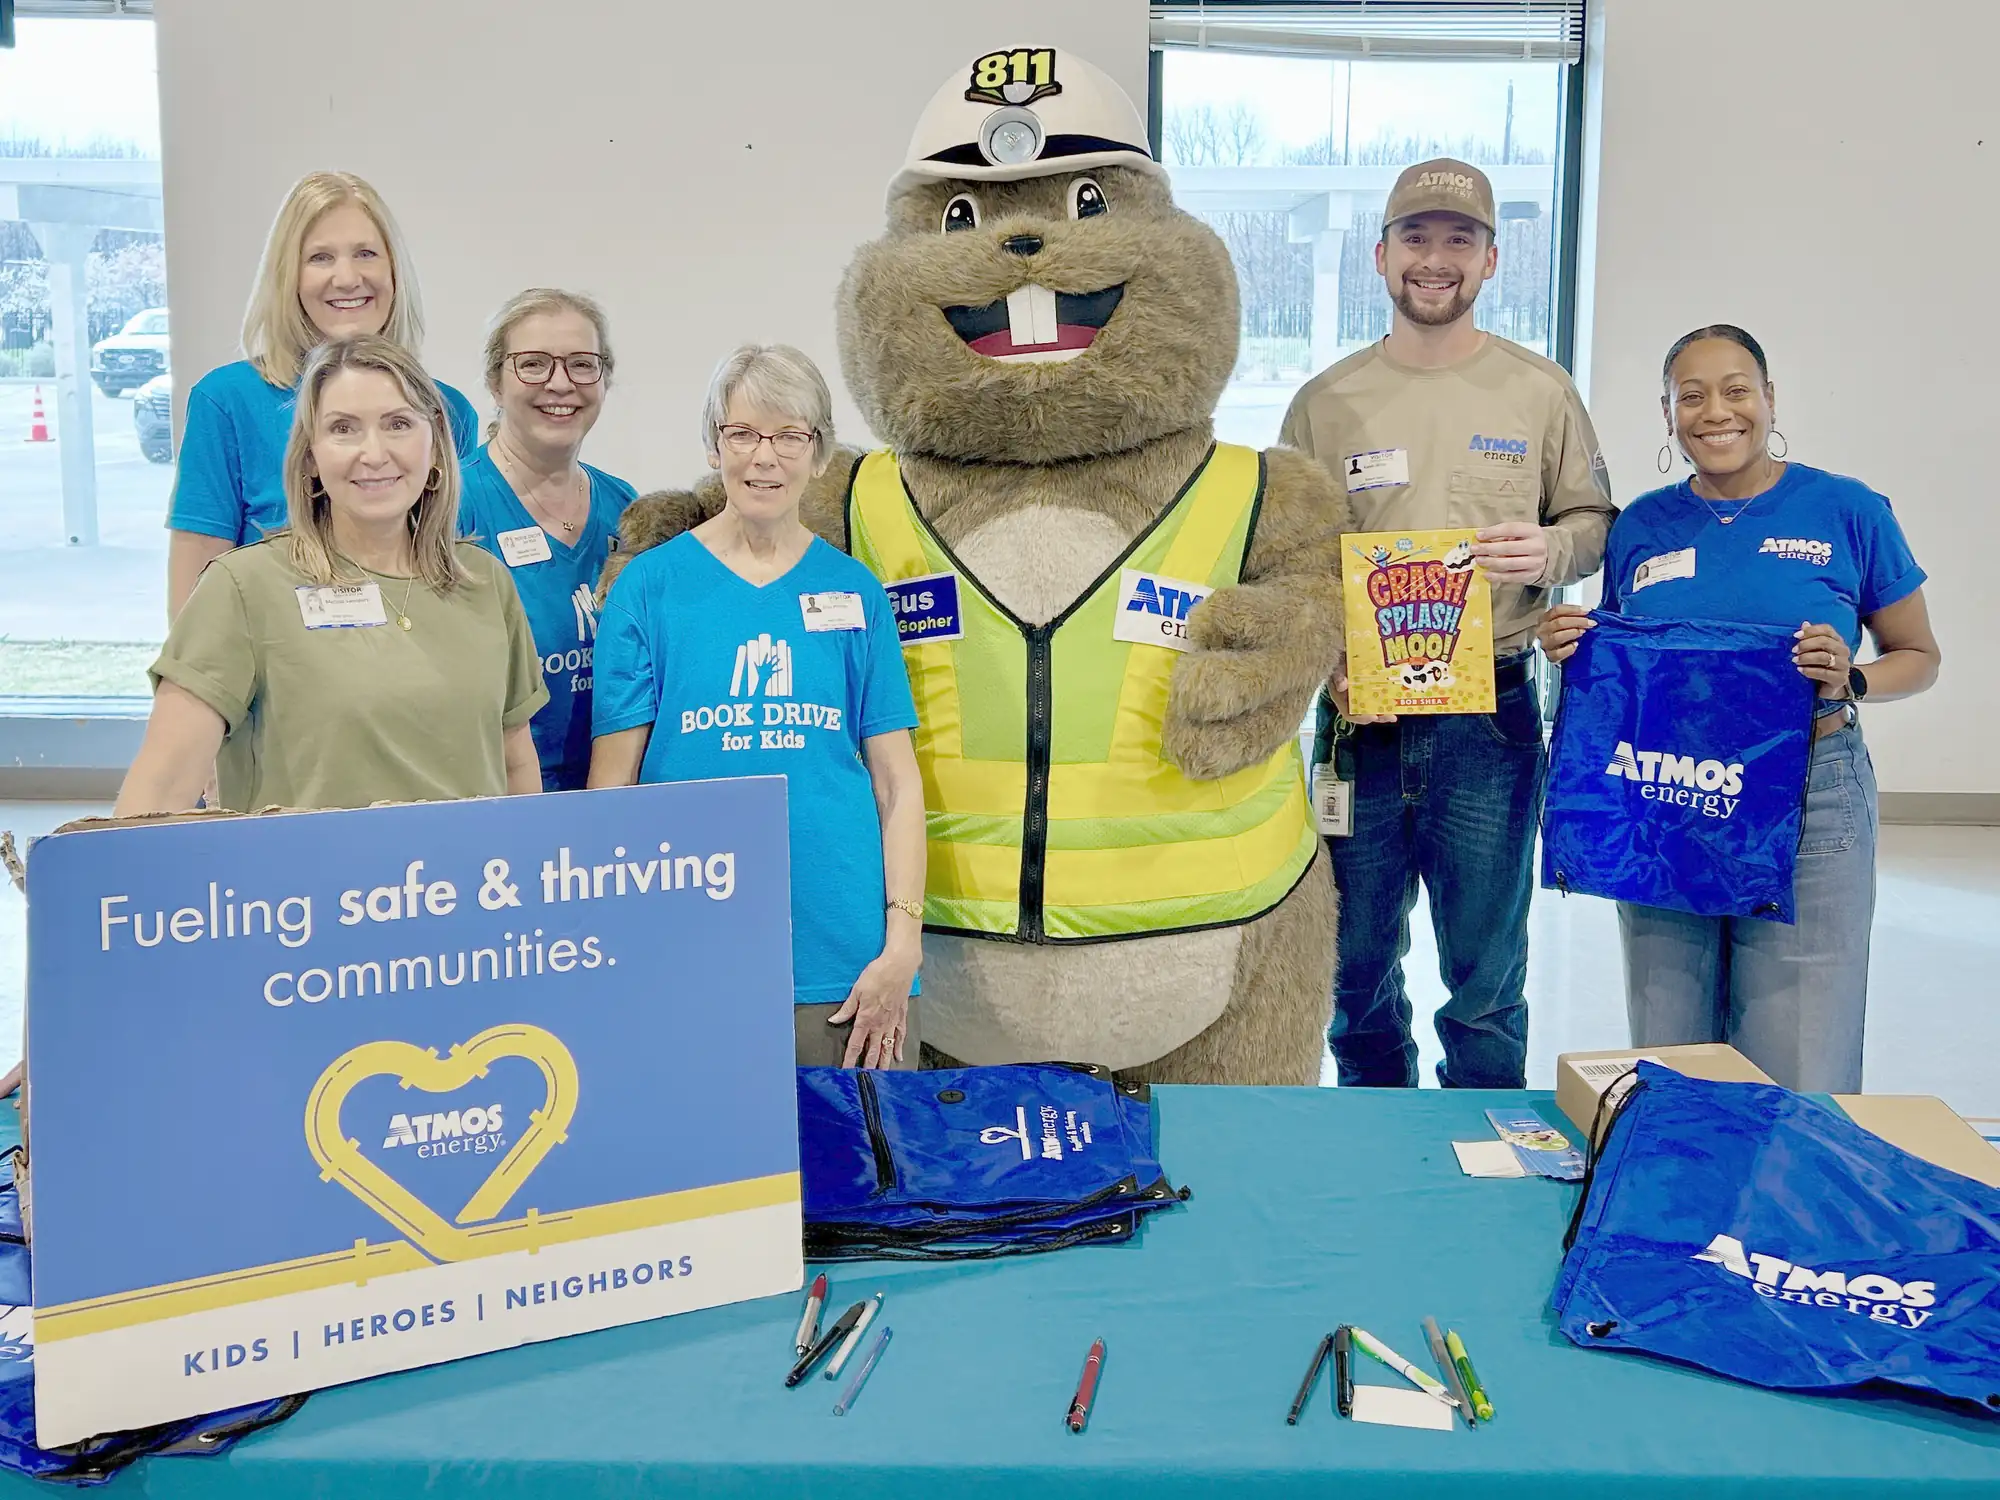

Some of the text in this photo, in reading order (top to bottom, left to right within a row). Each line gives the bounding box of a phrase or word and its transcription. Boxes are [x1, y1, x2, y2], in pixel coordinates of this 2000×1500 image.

[975, 51, 1052, 89] 811
[1415, 171, 1474, 190] ATMOS
[1430, 185, 1473, 199] energy
[1469, 434, 1528, 455] ATMOS
[1483, 451, 1526, 465] energy
[1758, 537, 1833, 557] ATMOS
[1778, 551, 1831, 567] energy
[887, 590, 935, 615] Gus
[1126, 577, 1204, 621] ATM
[898, 616, 953, 634] Gopher
[1384, 632, 1453, 665] MOO!
[681, 702, 842, 734] BOOK DRIVE
[721, 730, 806, 751] for Kids
[1605, 740, 1745, 796] ATMOS
[1640, 784, 1740, 819] energy
[100, 841, 735, 951] Fueling safe & thriving
[263, 928, 617, 1007] communities.
[382, 1103, 503, 1149] ATMOS
[1690, 1233, 1936, 1307] ATMOS
[183, 1337, 269, 1377] KIDS
[323, 1299, 457, 1347] HEROES
[505, 1254, 694, 1310] NEIGHBORS
[1752, 1282, 1934, 1329] energy
